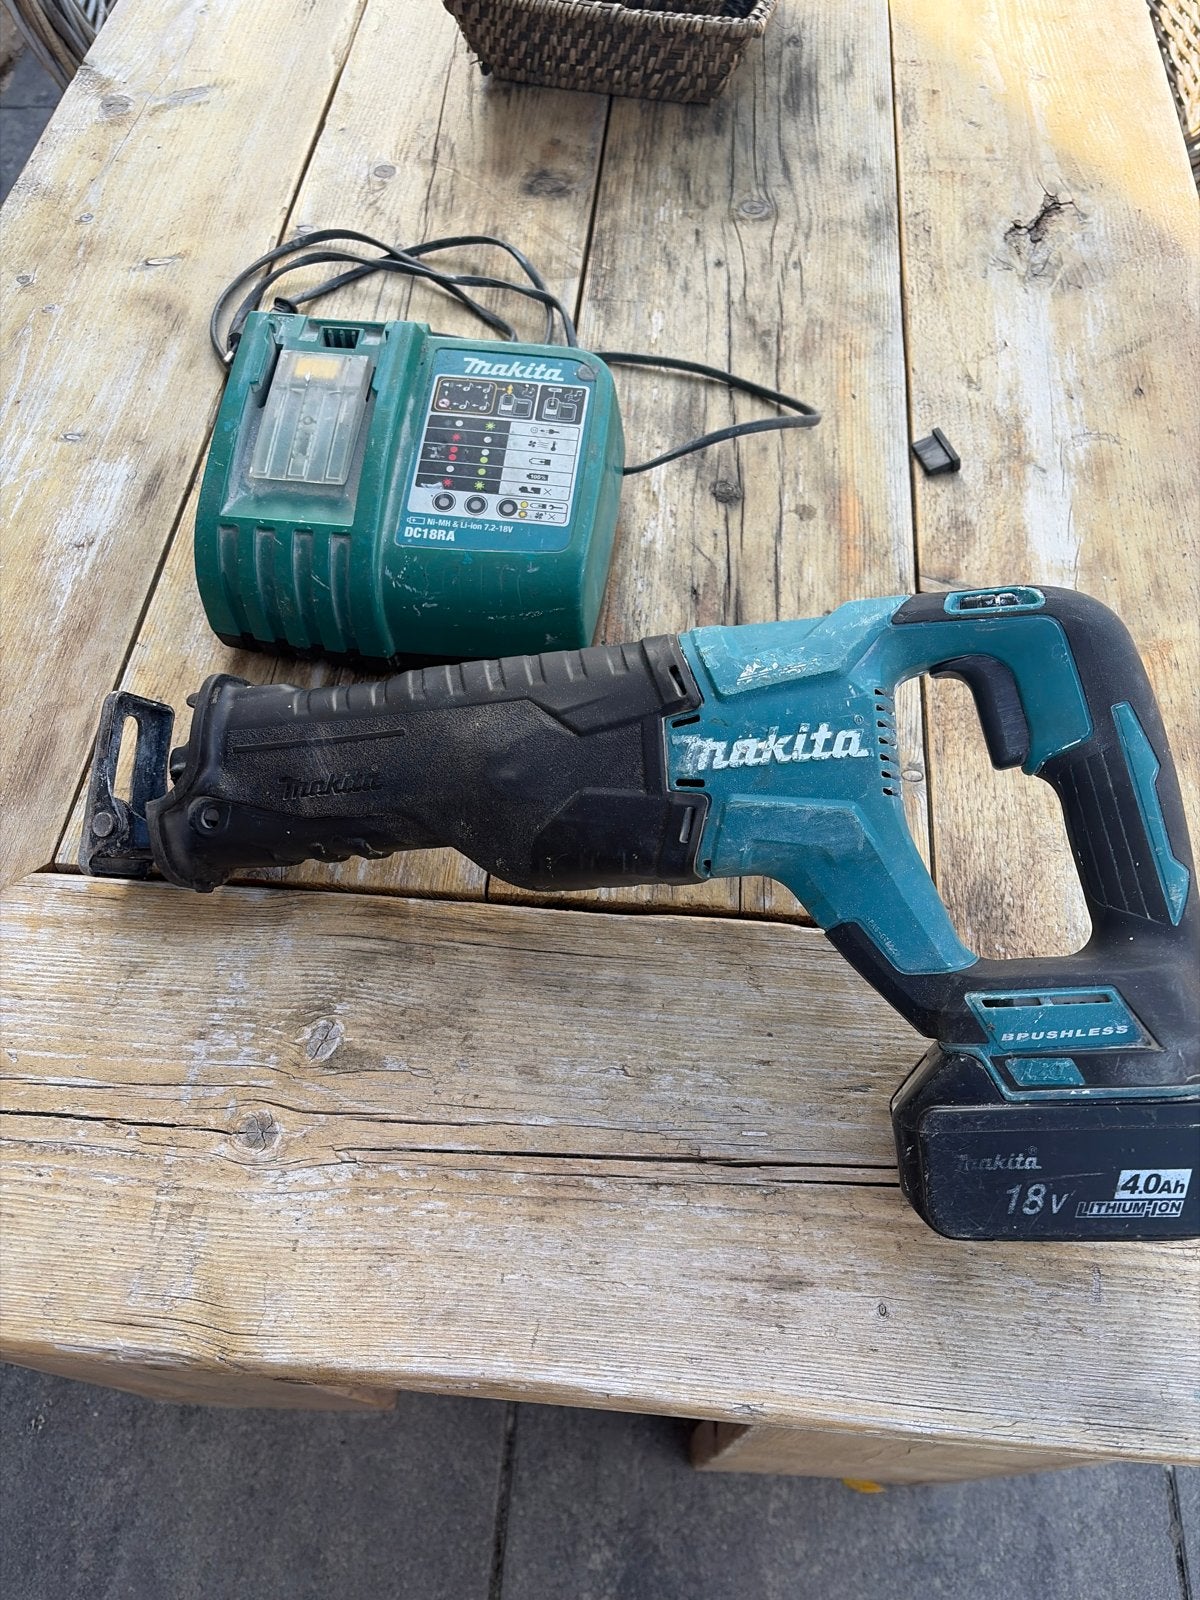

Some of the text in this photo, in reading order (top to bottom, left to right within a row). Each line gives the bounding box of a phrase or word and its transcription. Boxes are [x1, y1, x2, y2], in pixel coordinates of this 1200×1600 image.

[427, 518, 451, 527] Ni-MH
[484, 523, 514, 533] 7.2-18V
[404, 526, 455, 542] DC18RA
[1121, 1173, 1186, 1195] 4.0Ah
[1077, 1201, 1183, 1217] LITHIUM-ION
